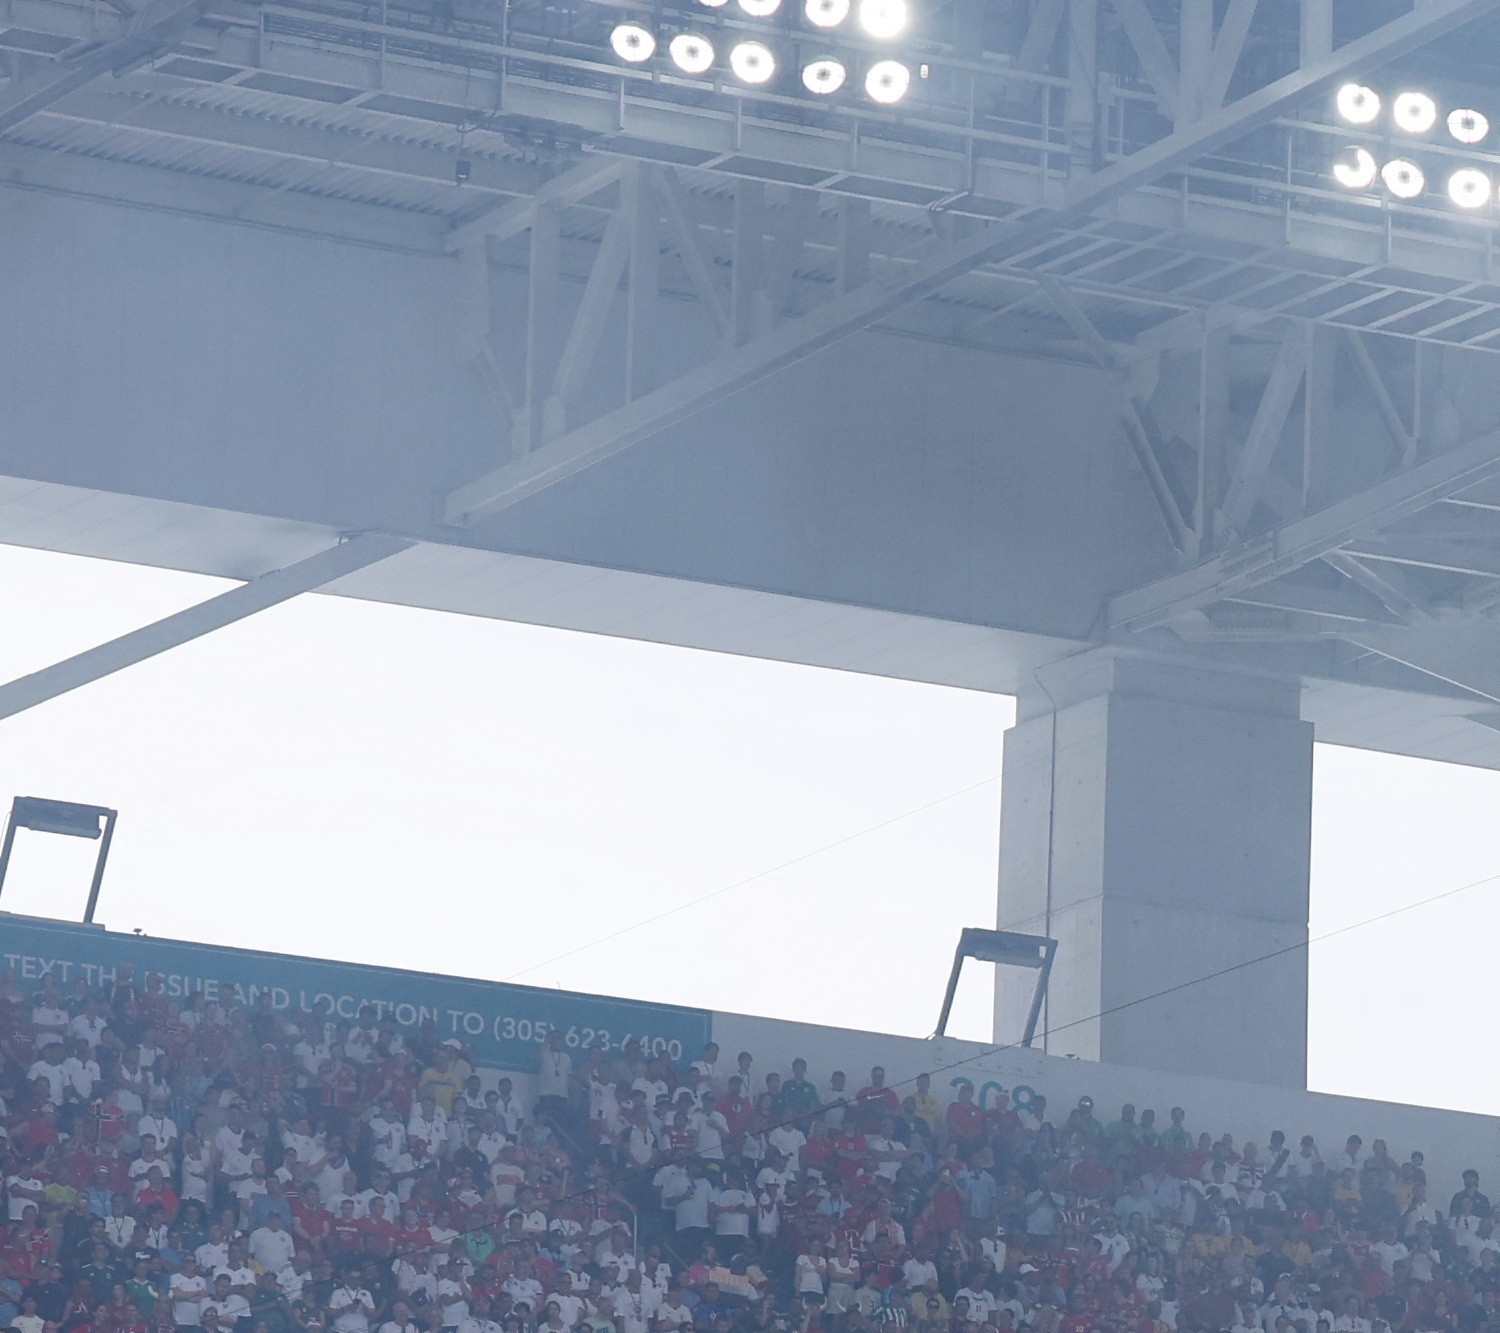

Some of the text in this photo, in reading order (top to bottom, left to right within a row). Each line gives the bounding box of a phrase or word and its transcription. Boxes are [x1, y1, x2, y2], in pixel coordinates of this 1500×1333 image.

[4, 954, 73, 984] TEXT
[81, 963, 117, 988] TH
[300, 990, 438, 1027] LOCATION
[447, 1010, 484, 1035] TO
